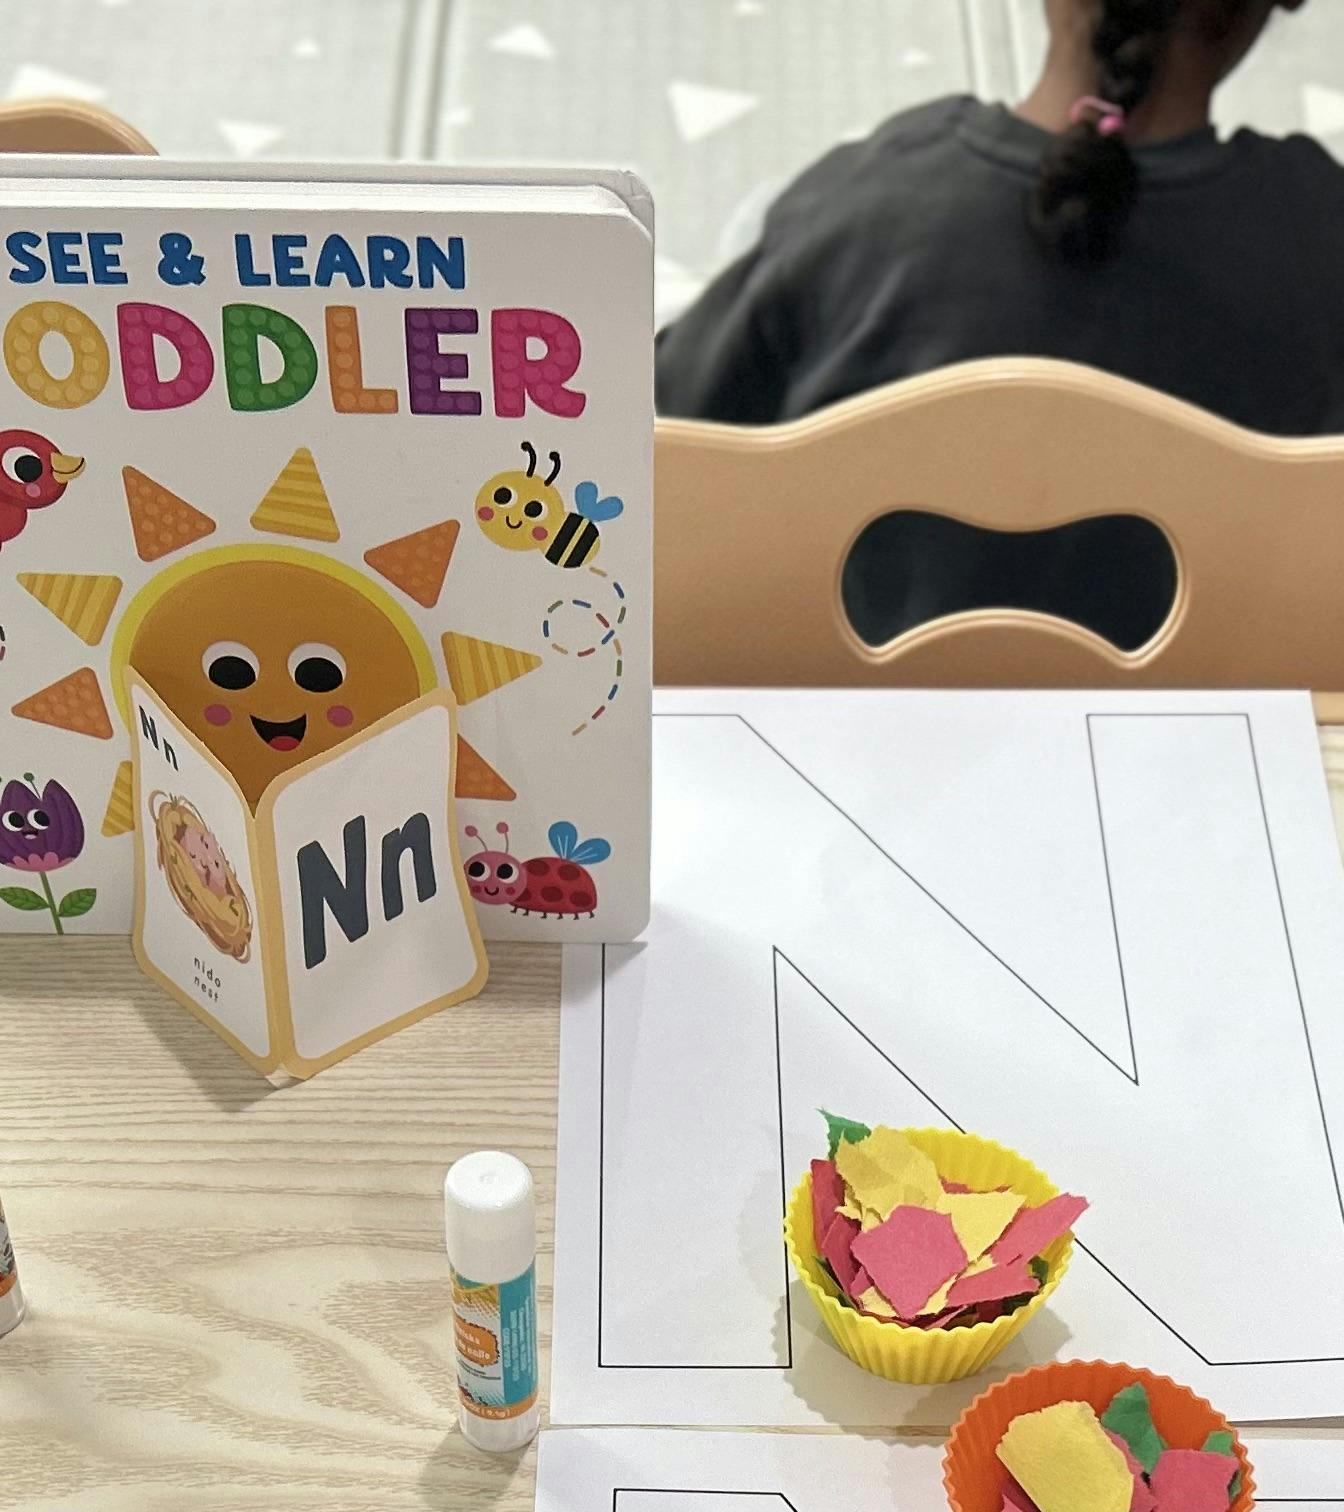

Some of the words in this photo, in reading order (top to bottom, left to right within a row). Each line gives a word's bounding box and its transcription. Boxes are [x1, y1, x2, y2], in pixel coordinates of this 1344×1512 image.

[6, 230, 129, 286] SEE
[156, 232, 206, 286] &
[235, 233, 467, 290] LEARN
[296, 811, 437, 970] Nn
[193, 957, 221, 988] nido
[193, 976, 219, 1002] nest
